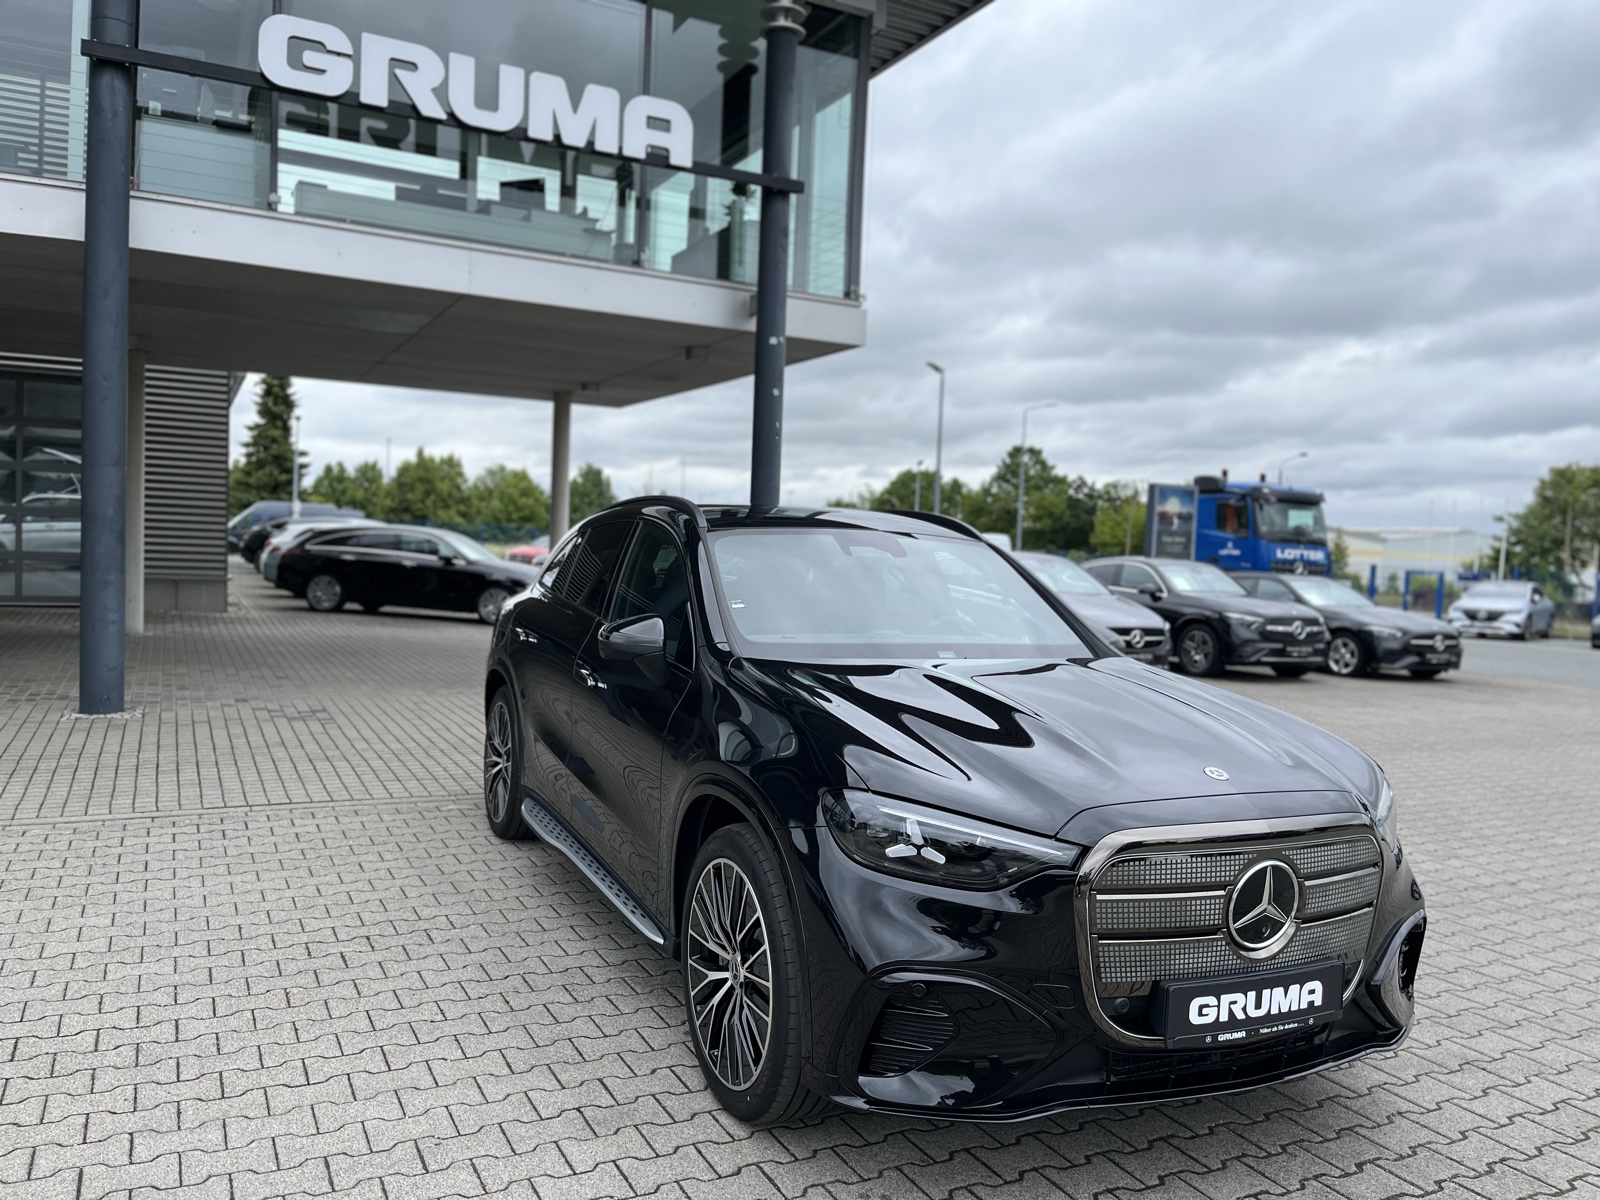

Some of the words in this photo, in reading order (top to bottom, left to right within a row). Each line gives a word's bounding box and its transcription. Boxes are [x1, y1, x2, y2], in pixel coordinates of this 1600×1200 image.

[258, 14, 694, 168] GRUMA
[1276, 548, 1325, 560] LOTTER
[1189, 980, 1323, 1025] GRUMA
[1217, 1031, 1246, 1041] GRUMA
